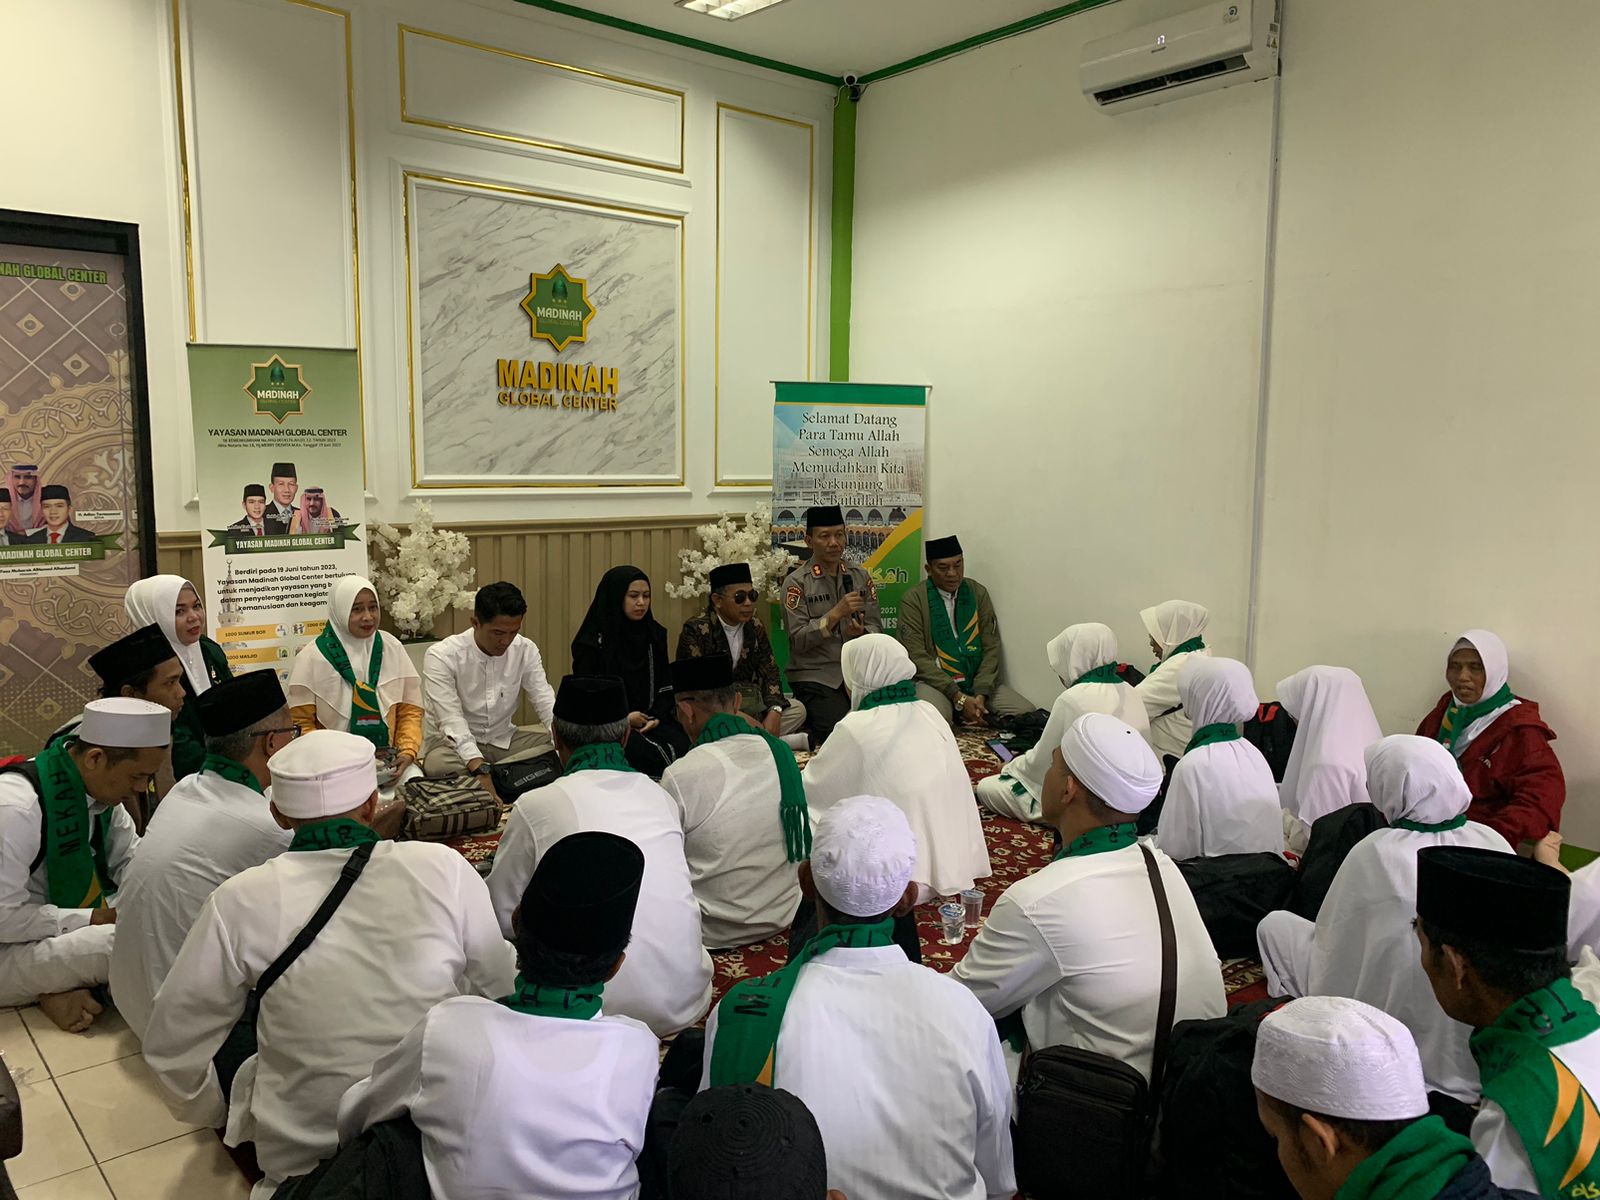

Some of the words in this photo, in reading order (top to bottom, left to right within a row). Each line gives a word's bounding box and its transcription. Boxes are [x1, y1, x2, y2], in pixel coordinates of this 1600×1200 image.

[23, 264, 65, 280] GLOBAL
[67, 268, 108, 284] CENTER
[536, 306, 583, 321] MADINAH
[496, 359, 619, 395] MADINAH
[257, 389, 299, 400] MADINAH
[497, 391, 559, 409] GLOBAL
[562, 394, 618, 412] CENTER
[802, 411, 850, 425] Selamat
[854, 413, 898, 428] Datang
[208, 429, 247, 437] YAYASAN
[248, 429, 285, 437] MADINAH
[285, 429, 316, 437] GLOBAL
[317, 429, 347, 437] CENTER
[799, 428, 826, 441] Para
[829, 429, 864, 441] Tamu
[868, 430, 900, 442] Allah
[808, 445, 854, 459] Semoga
[858, 446, 889, 458] Allah
[792, 461, 877, 474] Memudahkan
[881, 462, 904, 474] Kita
[814, 478, 884, 492] Berkunjung
[813, 494, 826, 506] ke
[235, 540, 263, 549] YAYASAN
[264, 538, 291, 548] MADINAH
[292, 538, 314, 547] GLOBAL
[314, 537, 335, 546] CENTER
[0, 549, 34, 560] MADINAH
[35, 548, 63, 558] GLOBAL
[65, 547, 92, 557] CENTER
[234, 567, 258, 576] Berdiri
[258, 567, 277, 576] pada
[285, 565, 299, 573] Juni
[299, 564, 320, 572] tahun
[320, 563, 338, 571] 2023,
[217, 577, 248, 587] Yayasan
[248, 576, 279, 584] Madinah
[279, 574, 301, 583] Global
[301, 573, 324, 581] Center
[217, 587, 238, 596] untuk
[238, 585, 280, 595] menjadikan
[281, 583, 310, 593] yayasan
[310, 582, 327, 591] yang
[220, 595, 243, 604] dalam
[244, 593, 304, 603] penyelenggaraan
[238, 603, 285, 612] kemanusiaan
[285, 601, 299, 609] dan
[881, 607, 897, 615] 2021
[50, 769, 81, 857] MEKAH
